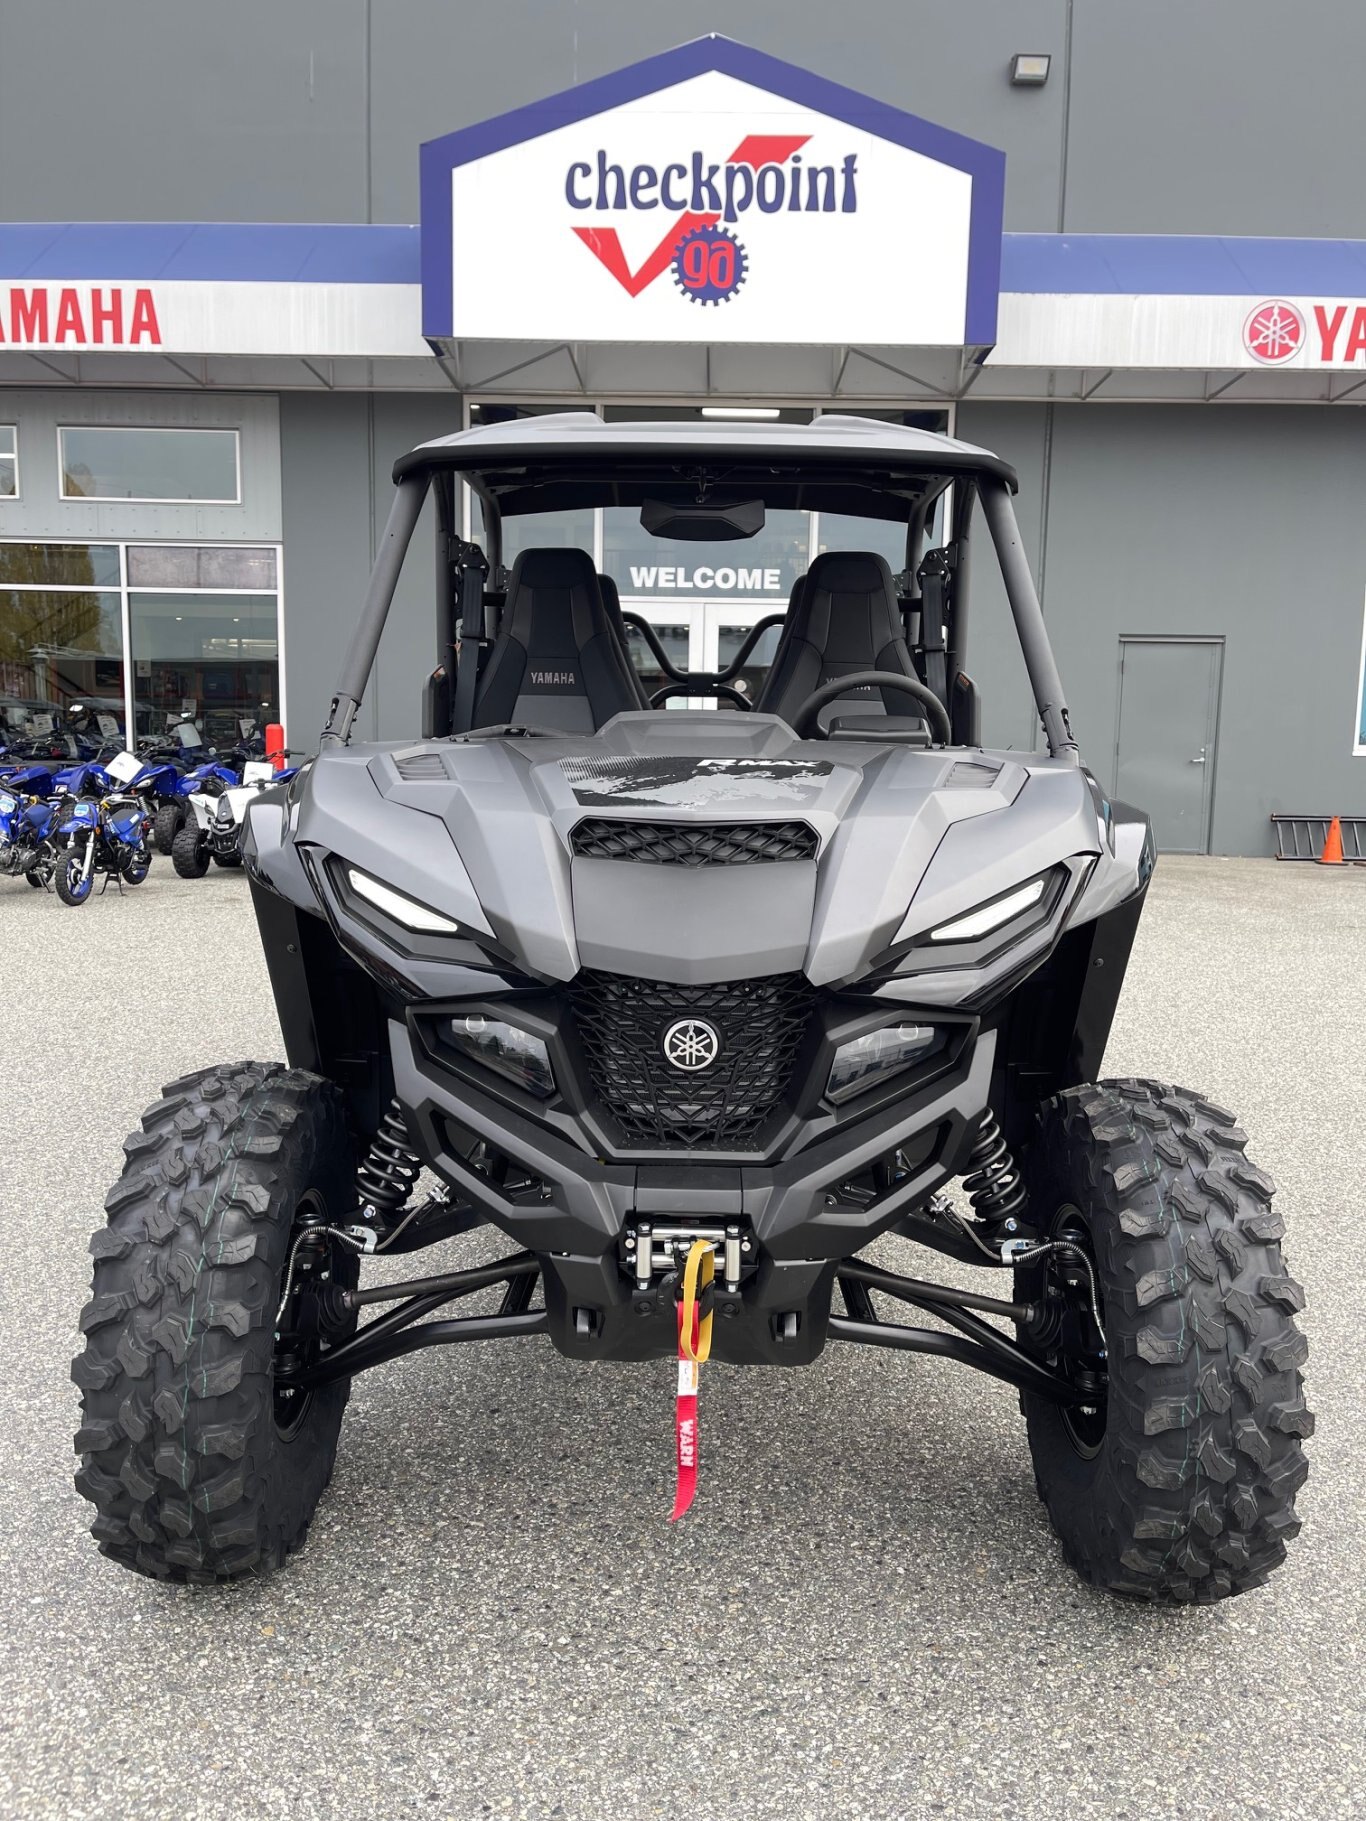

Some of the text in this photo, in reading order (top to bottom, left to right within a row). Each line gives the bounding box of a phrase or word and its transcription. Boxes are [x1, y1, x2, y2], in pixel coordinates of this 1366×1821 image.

[565, 149, 858, 223] checkpoint
[0, 288, 161, 344] MAHA
[1313, 305, 1366, 362] YA
[629, 566, 781, 590] WELCOME
[530, 672, 575, 684] YAMAHA
[679, 1419, 694, 1467] WARN
